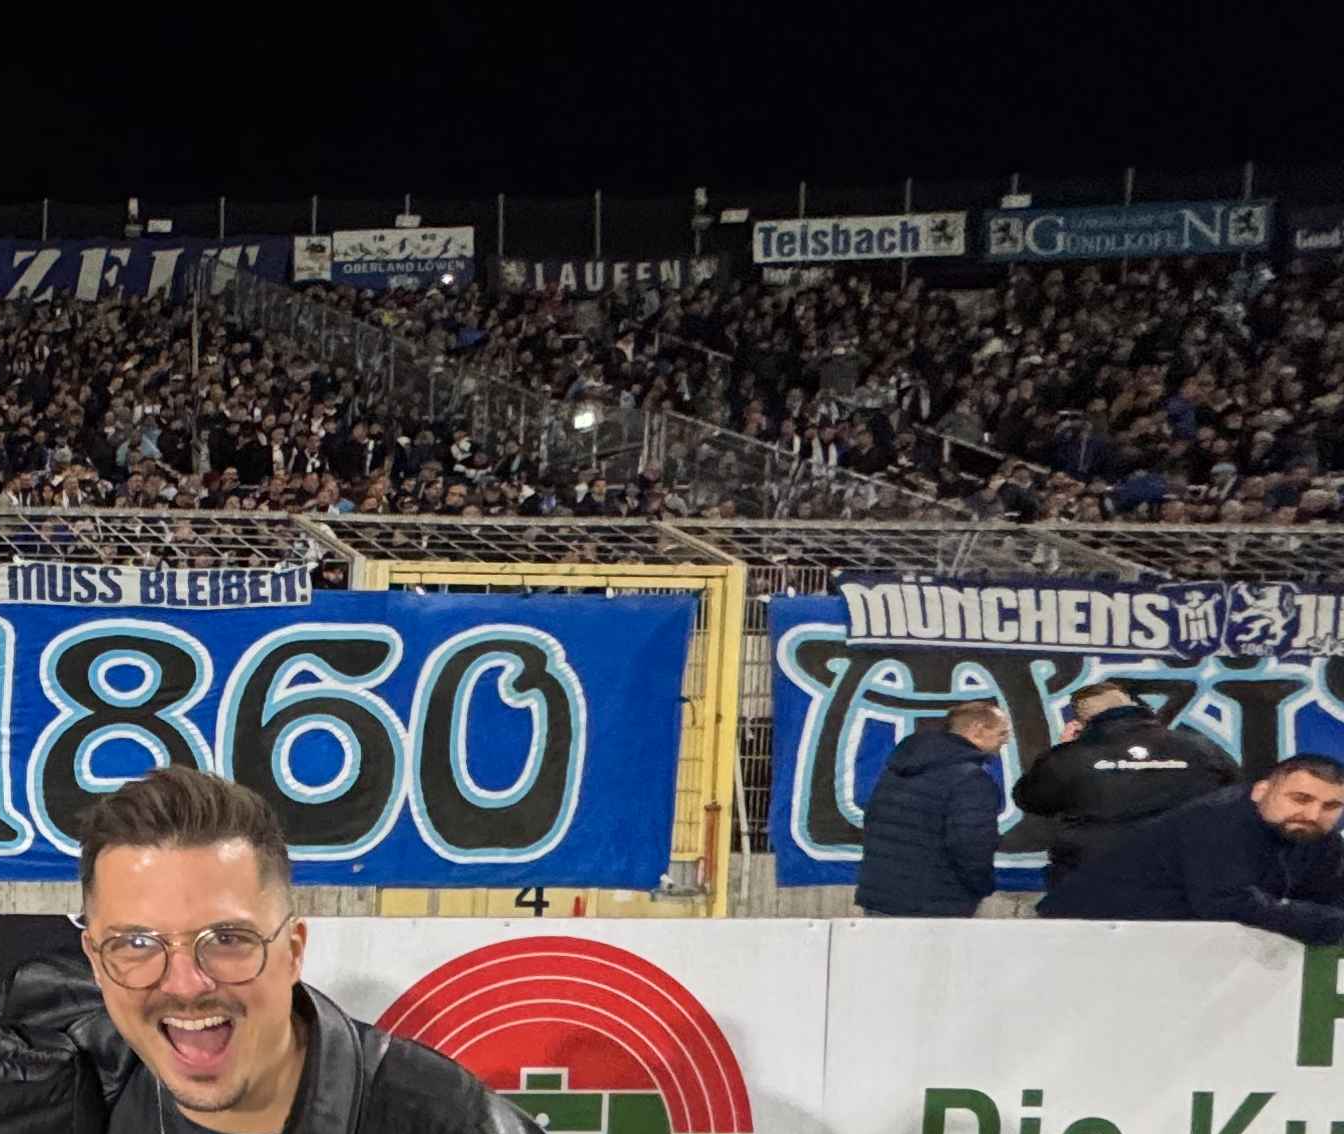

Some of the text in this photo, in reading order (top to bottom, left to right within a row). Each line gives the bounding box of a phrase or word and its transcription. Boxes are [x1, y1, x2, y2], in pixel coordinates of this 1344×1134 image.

[6, 563, 123, 604] MUSS
[139, 566, 310, 606] BLEIBEN!
[841, 576, 1170, 652] MÜNCHENS
[514, 886, 550, 917] 4
